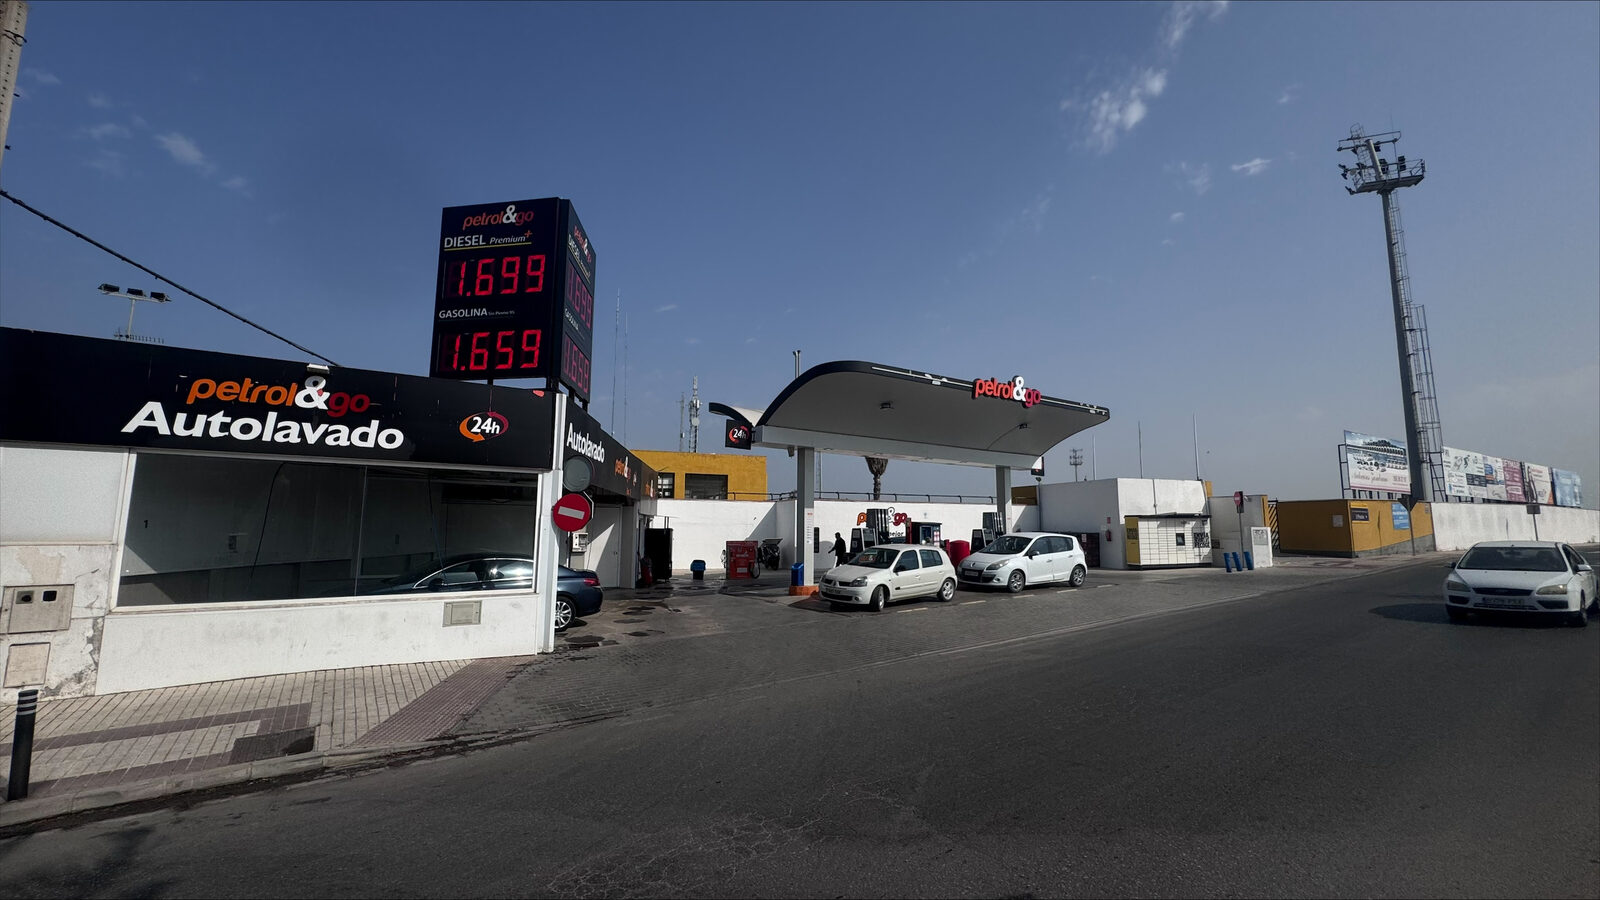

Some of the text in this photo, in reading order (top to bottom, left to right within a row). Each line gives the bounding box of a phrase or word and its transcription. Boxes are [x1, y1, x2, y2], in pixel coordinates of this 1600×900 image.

[443, 234, 487, 248] DIESEL
[458, 254, 546, 296] 1.699
[438, 307, 488, 319] GASOLINA
[452, 329, 542, 371] 1.659
[120, 400, 405, 450] Autolavado
[470, 416, 501, 435] 24h
[733, 428, 747, 439] 24h
[566, 422, 606, 464] Autolavado
[143, 519, 149, 529] 1
